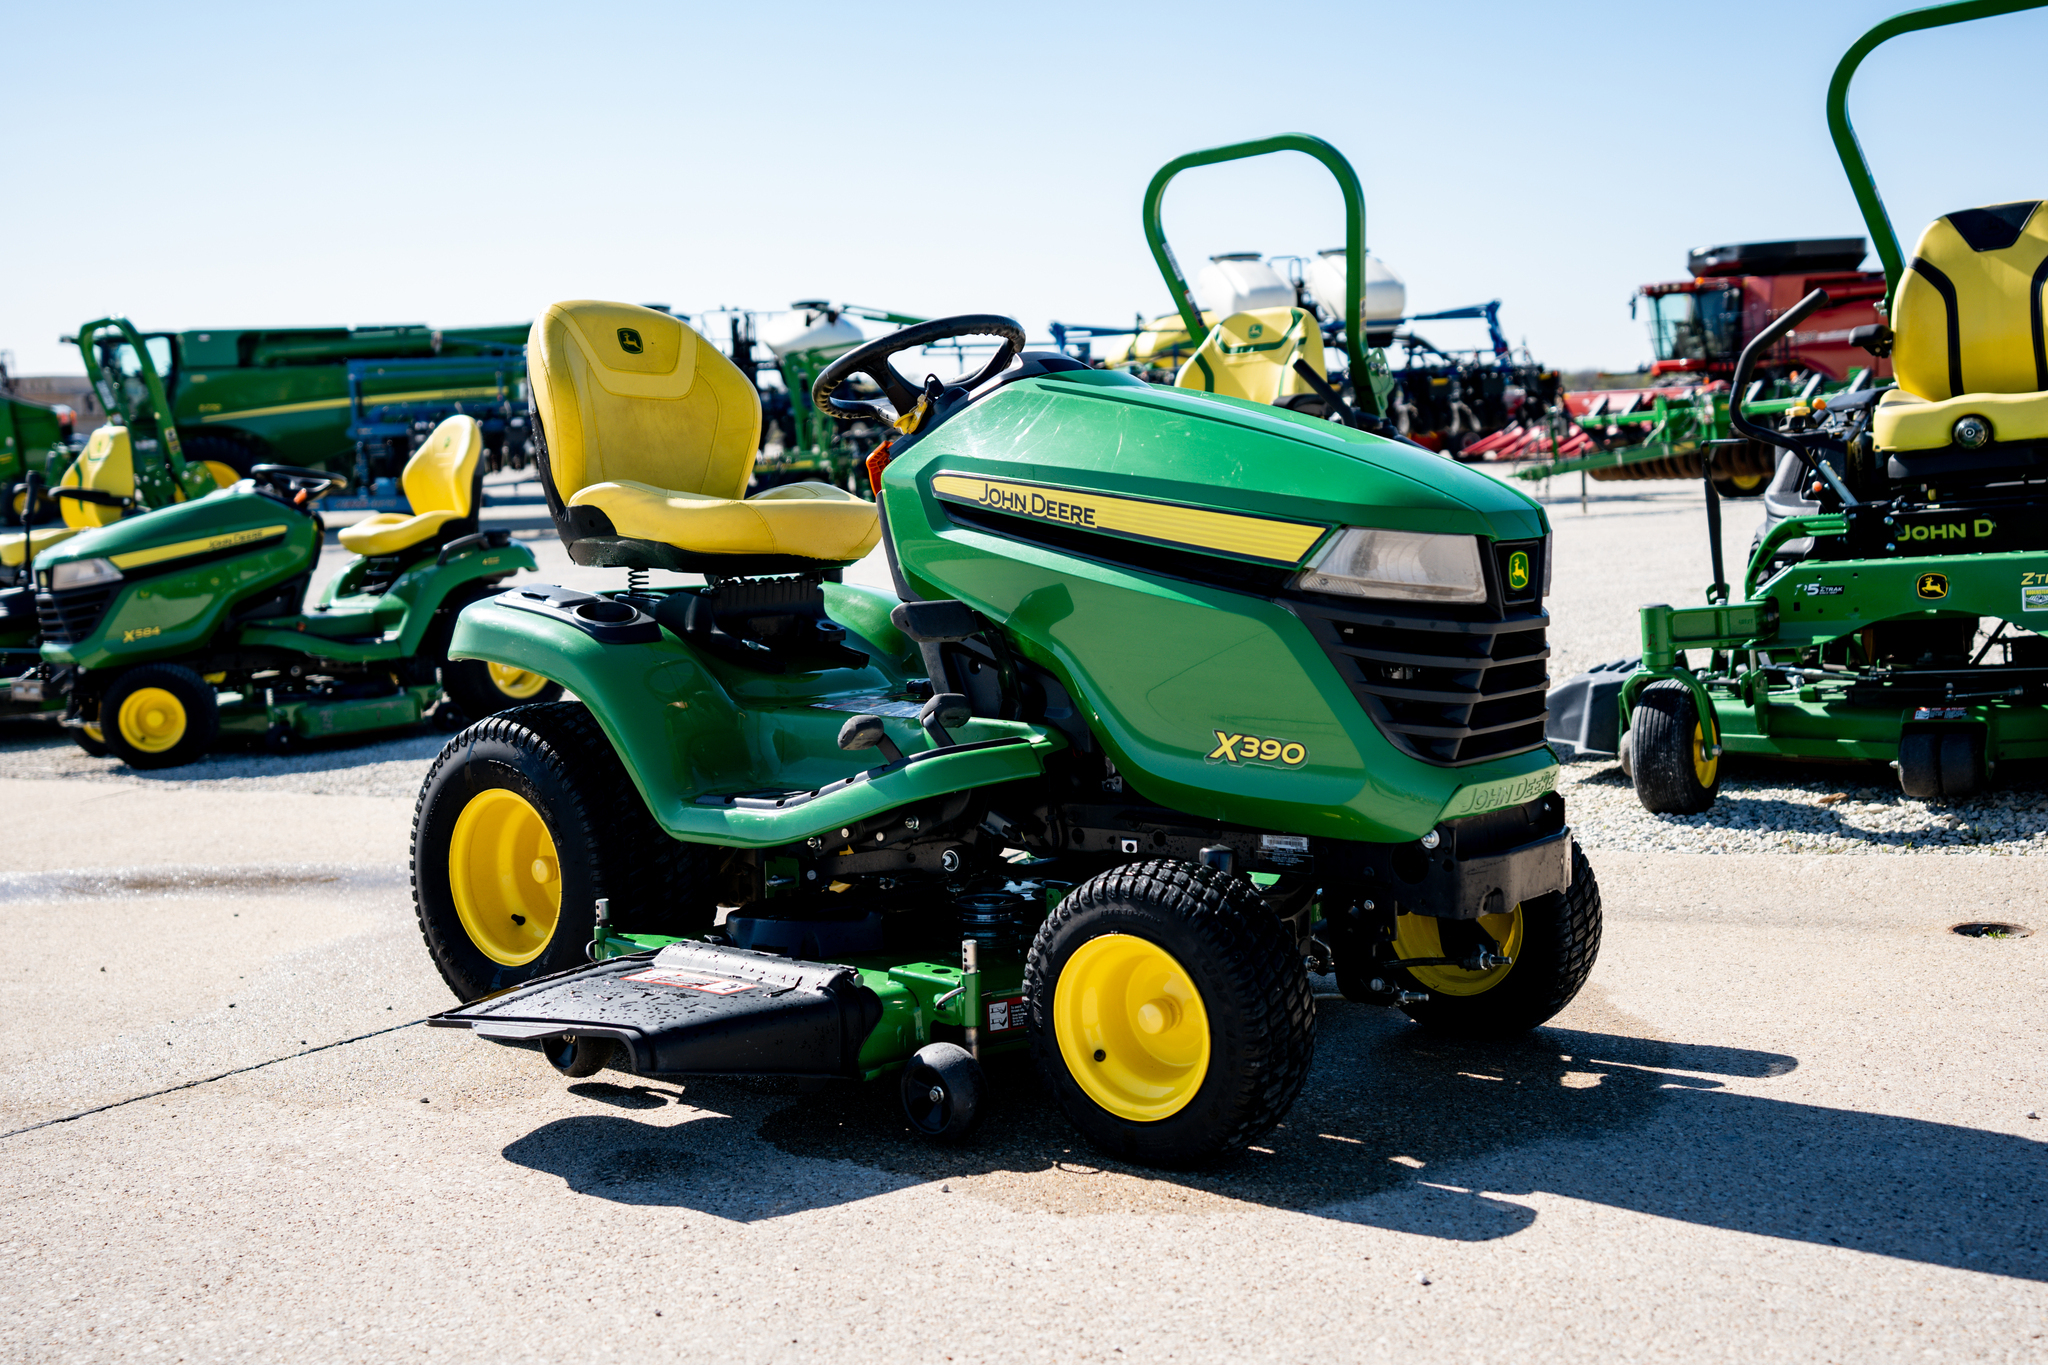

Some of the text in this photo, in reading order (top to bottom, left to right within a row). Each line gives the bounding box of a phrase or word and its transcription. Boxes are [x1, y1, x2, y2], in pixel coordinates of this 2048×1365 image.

[979, 483, 1096, 526] JOHN DEERE
[1897, 523, 1967, 541] JOHN
[122, 625, 161, 644] X584
[1206, 730, 1307, 766] X390
[1460, 770, 1557, 813] JOHN DEERE
